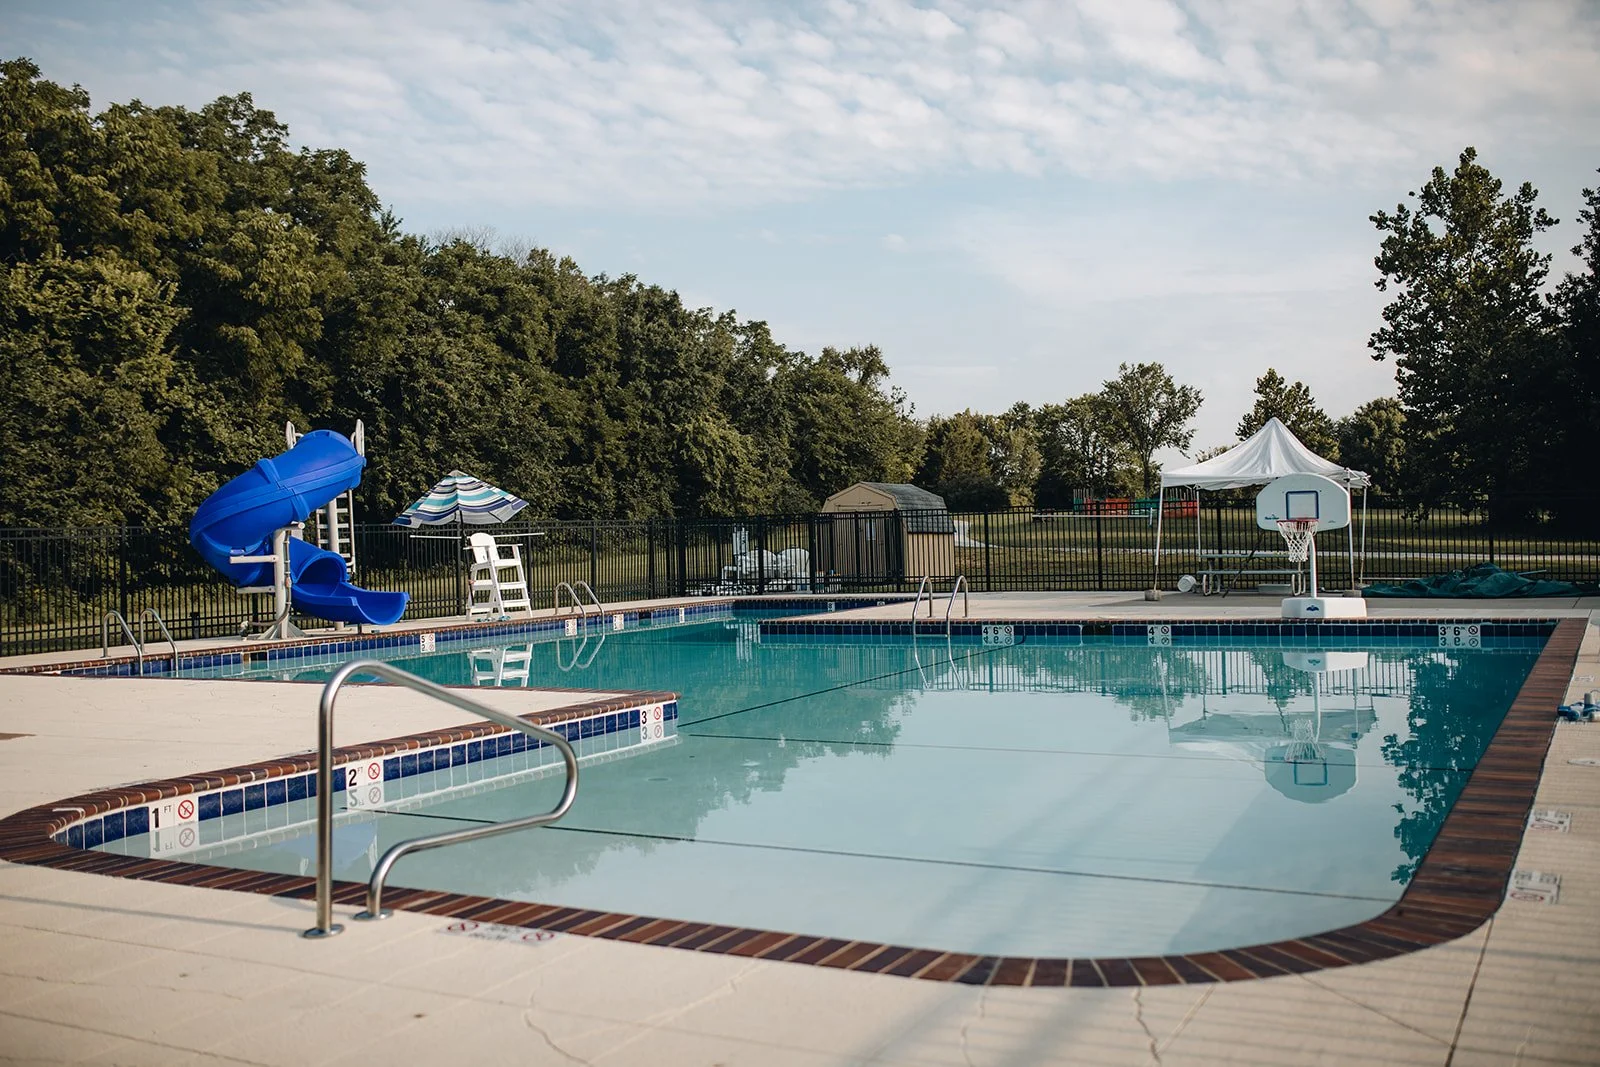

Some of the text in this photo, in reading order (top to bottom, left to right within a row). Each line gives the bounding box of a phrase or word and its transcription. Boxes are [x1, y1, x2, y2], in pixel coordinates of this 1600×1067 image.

[983, 626, 989, 635] 4
[993, 626, 999, 635] 6
[1149, 626, 1155, 636] 4
[1439, 626, 1447, 636] 3
[1453, 626, 1461, 636] 6
[641, 710, 648, 724] 3
[348, 768, 357, 787] 2
[151, 804, 172, 828] 1 FT
